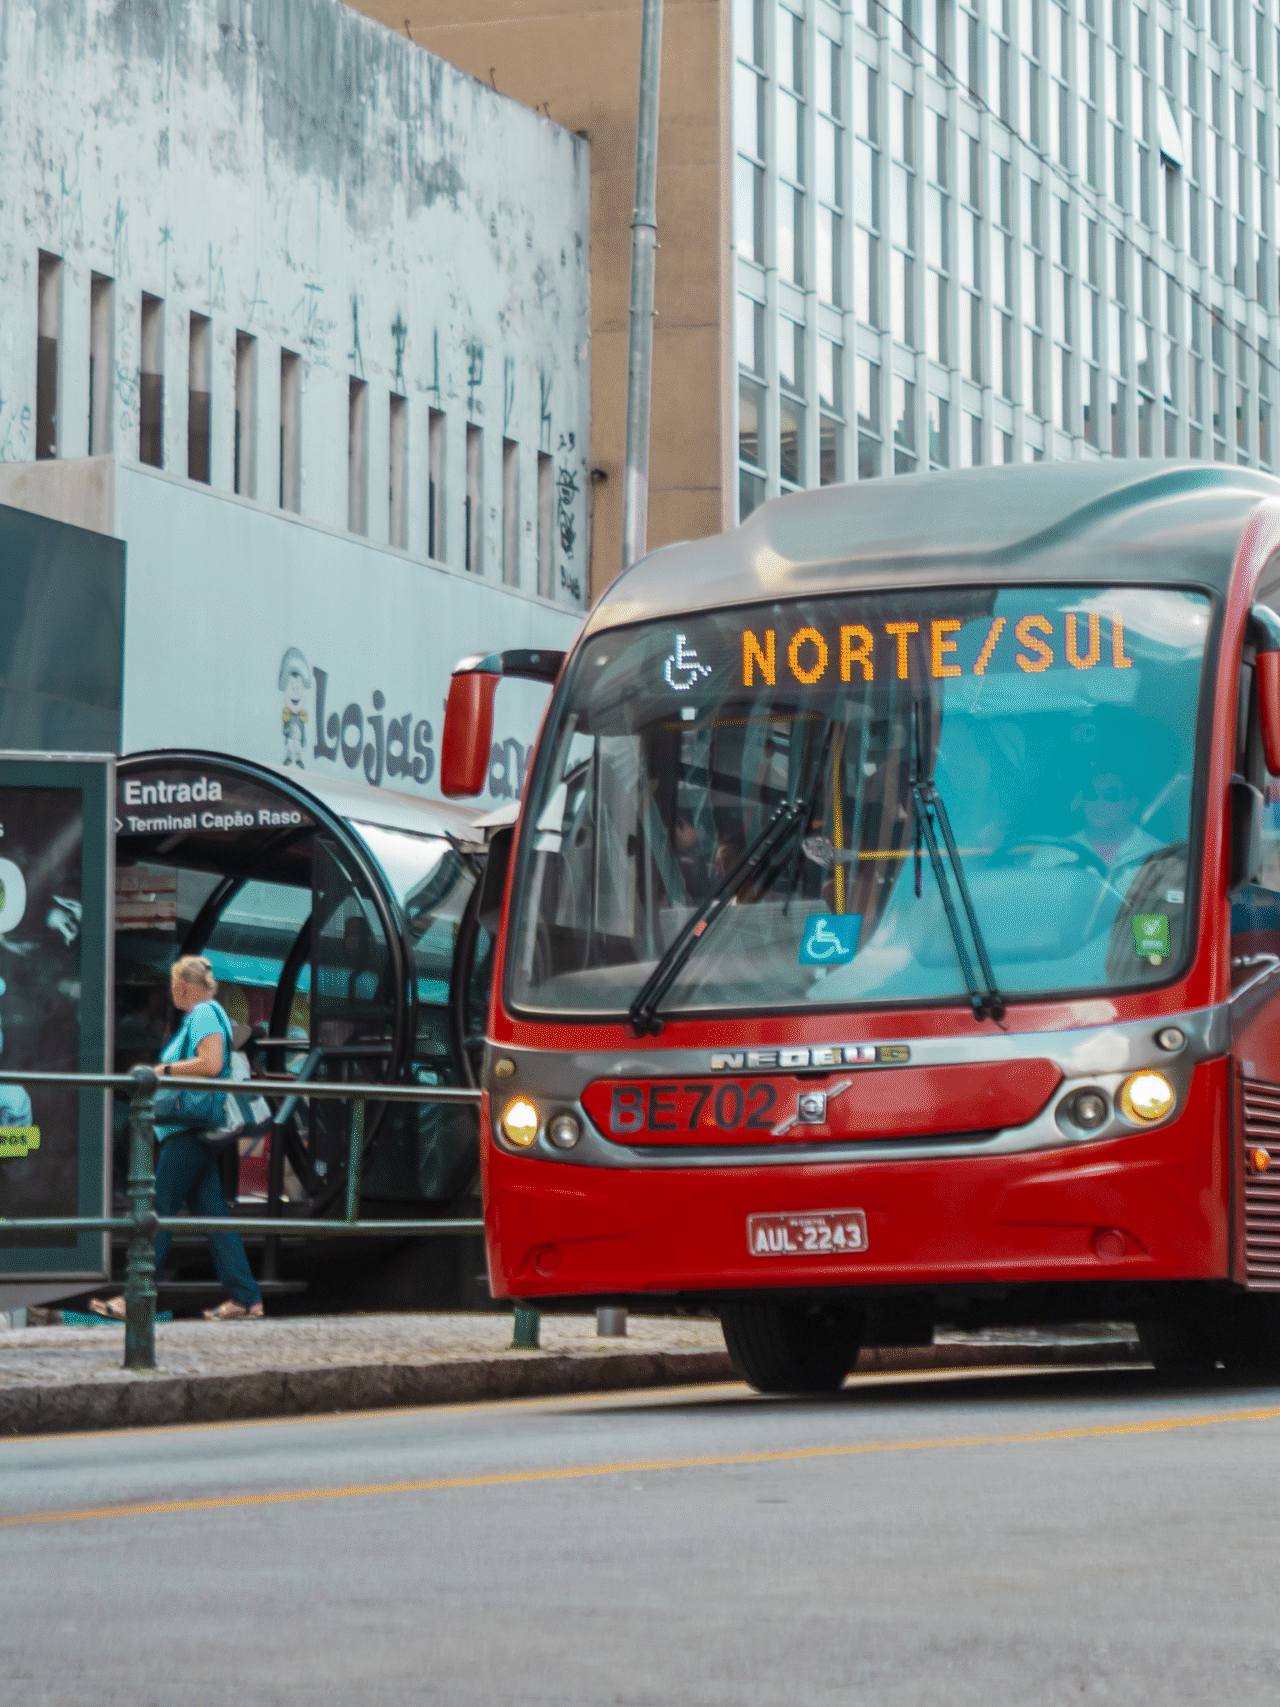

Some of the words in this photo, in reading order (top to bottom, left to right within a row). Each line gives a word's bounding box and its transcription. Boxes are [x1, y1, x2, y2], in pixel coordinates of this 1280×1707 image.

[742, 611, 1136, 687] NORTE/SUL
[312, 665, 435, 786] Lojas
[124, 777, 223, 805] Entrada
[127, 814, 197, 831] Terminal
[201, 810, 254, 831] Capão
[258, 808, 302, 825] Raso
[711, 1045, 910, 1071] NEOBUS
[610, 1083, 778, 1134] BE702
